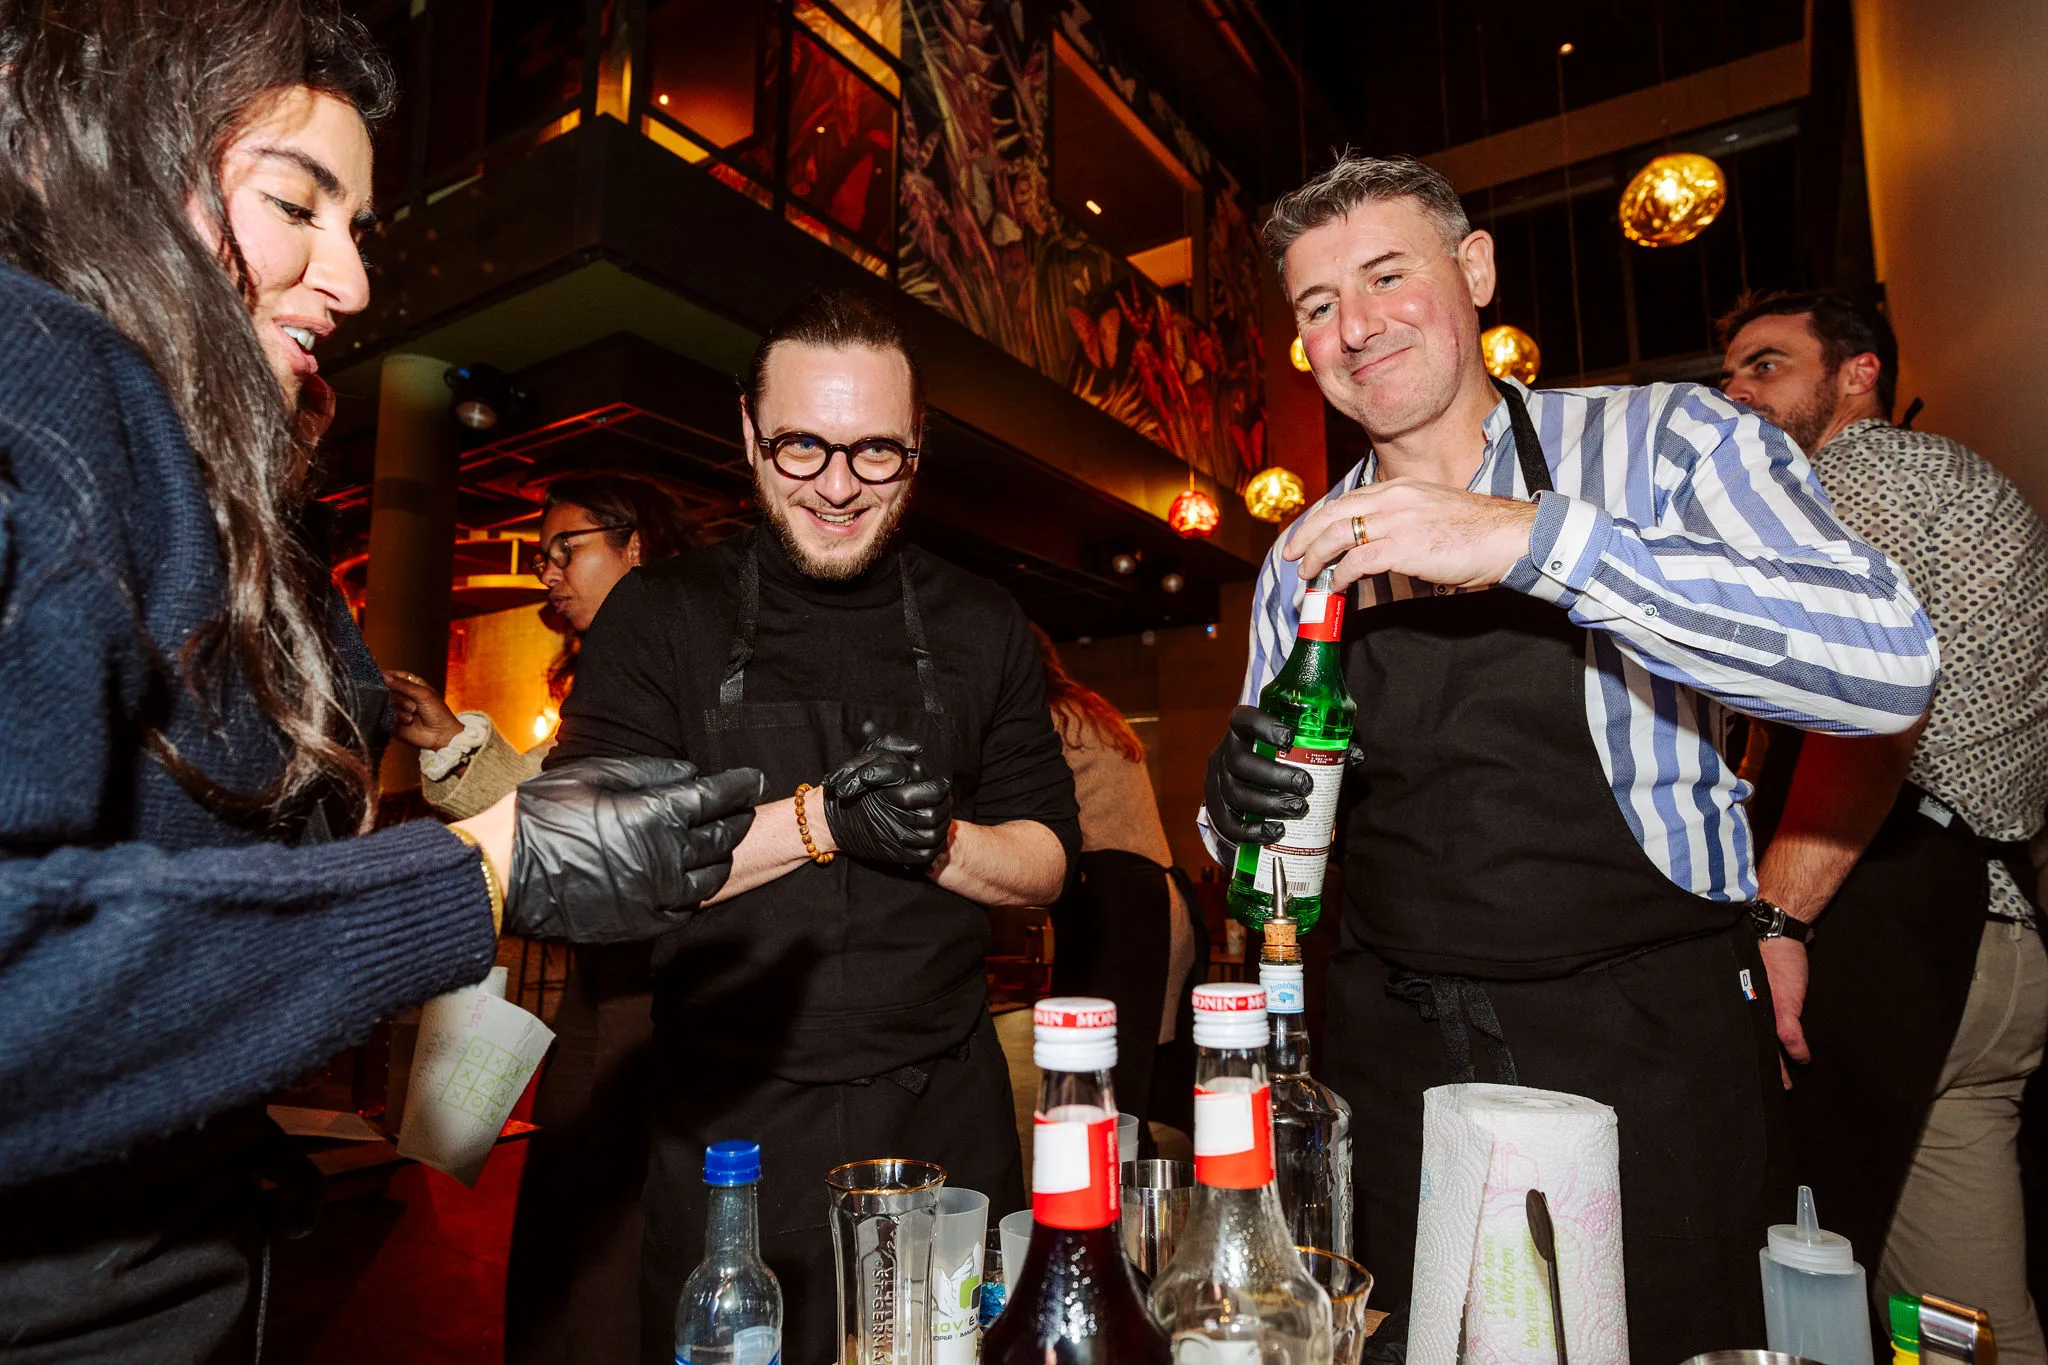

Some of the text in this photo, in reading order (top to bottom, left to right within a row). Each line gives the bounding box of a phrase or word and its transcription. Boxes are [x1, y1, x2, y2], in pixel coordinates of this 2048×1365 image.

[1332, 600, 1342, 637] monin.com
[1481, 1233, 1495, 1270] have
[1481, 1271, 1499, 1305] only
[1500, 1247, 1516, 1319] a kitchen
[1522, 1286, 1540, 1349] because
